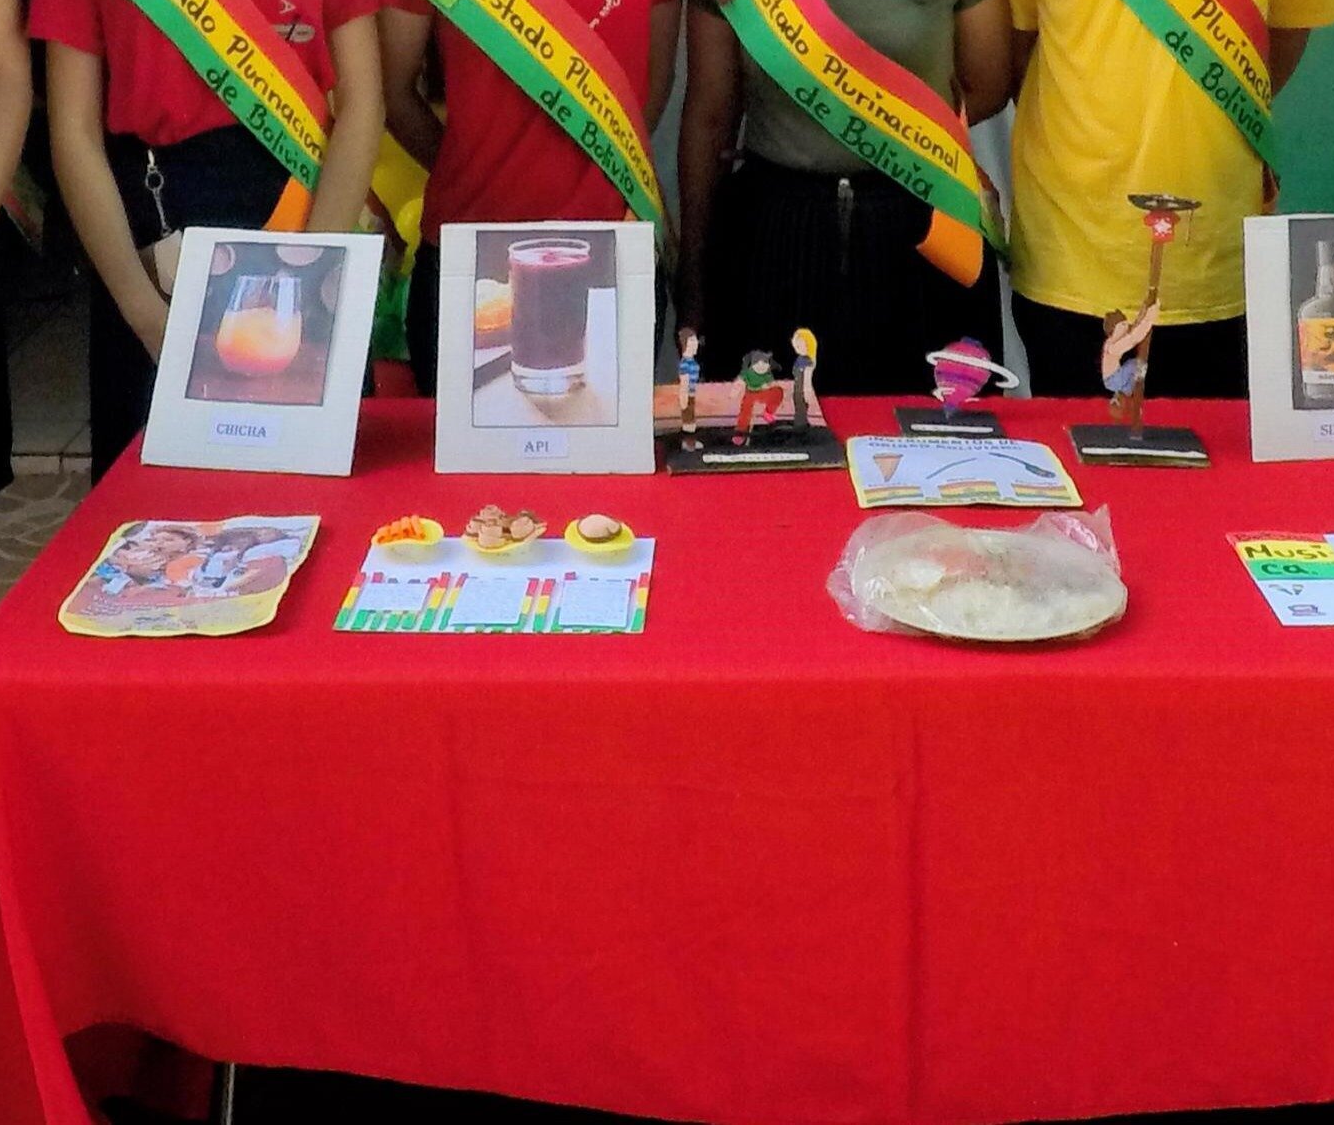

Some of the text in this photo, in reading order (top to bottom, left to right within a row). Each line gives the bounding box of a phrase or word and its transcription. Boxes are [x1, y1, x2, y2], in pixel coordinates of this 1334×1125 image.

[204, 67, 312, 185] de Bolivia
[226, 34, 323, 160] Plurinacion
[539, 87, 635, 196] de Bolivia
[822, 53, 960, 174] Plurinacional
[1164, 29, 1265, 142] de Bolivia
[794, 85, 935, 202] de Bolivia
[216, 423, 267, 438] CHICHA
[524, 440, 549, 453] API
